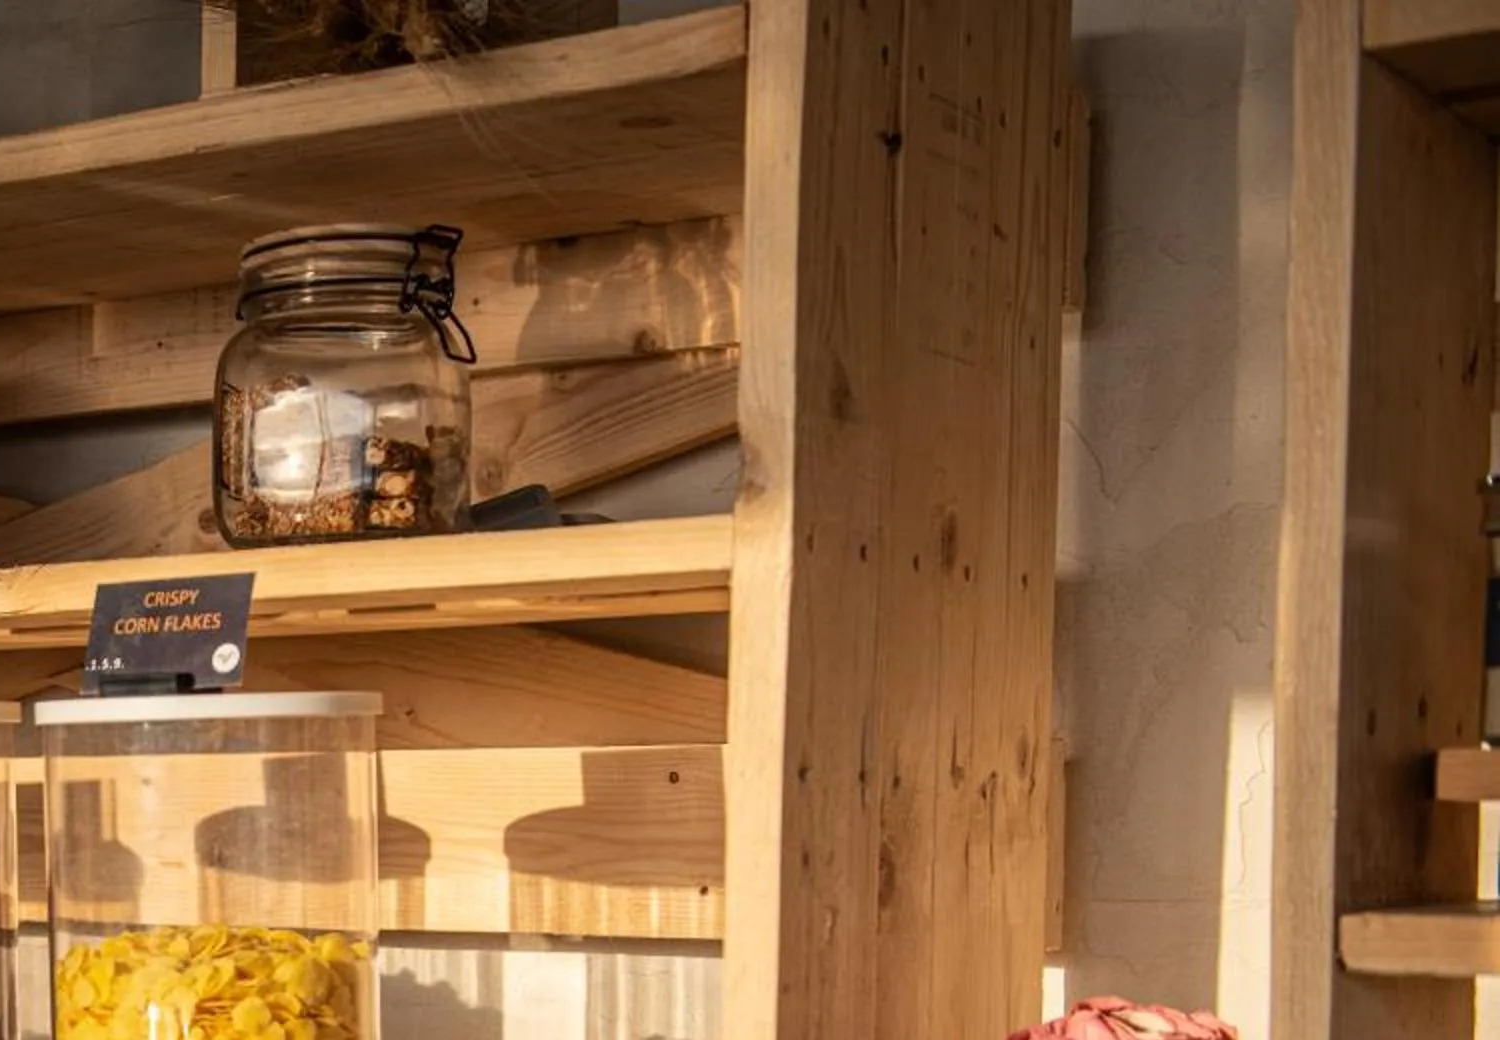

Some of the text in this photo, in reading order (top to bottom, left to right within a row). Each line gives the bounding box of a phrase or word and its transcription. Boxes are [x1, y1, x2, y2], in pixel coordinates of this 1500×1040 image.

[143, 588, 200, 608] CRISPY
[113, 612, 222, 635] CORN FLAKES
